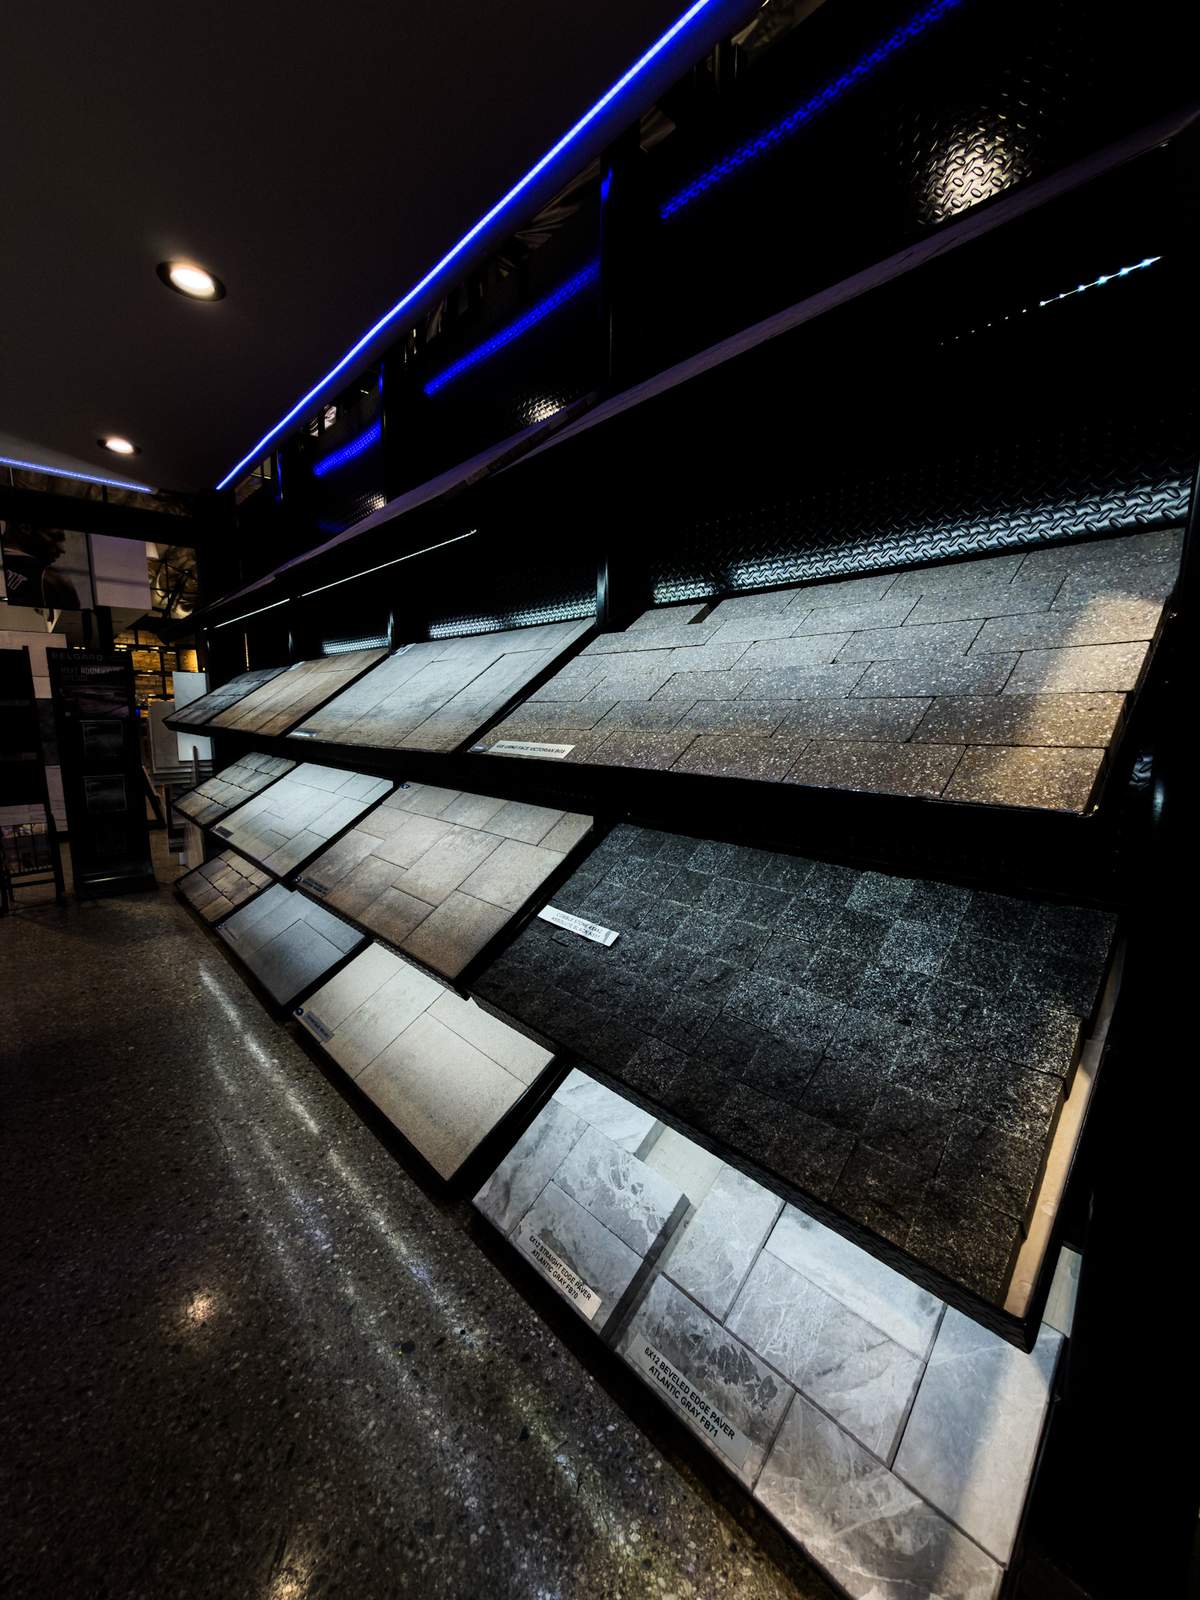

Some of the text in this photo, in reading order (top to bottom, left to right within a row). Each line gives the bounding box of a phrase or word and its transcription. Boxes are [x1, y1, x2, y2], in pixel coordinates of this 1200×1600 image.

[531, 1250, 554, 1273] ATLANTIC
[552, 1270, 567, 1286] GRAY
[539, 1244, 563, 1270] STRAIGHT
[561, 1267, 576, 1284] EDGE
[575, 1280, 592, 1301] PAVER
[644, 1347, 736, 1440] 6X12 BEVELED EDGE PAVER
[648, 1365, 719, 1438] ATLANTIC GRAY FB71
